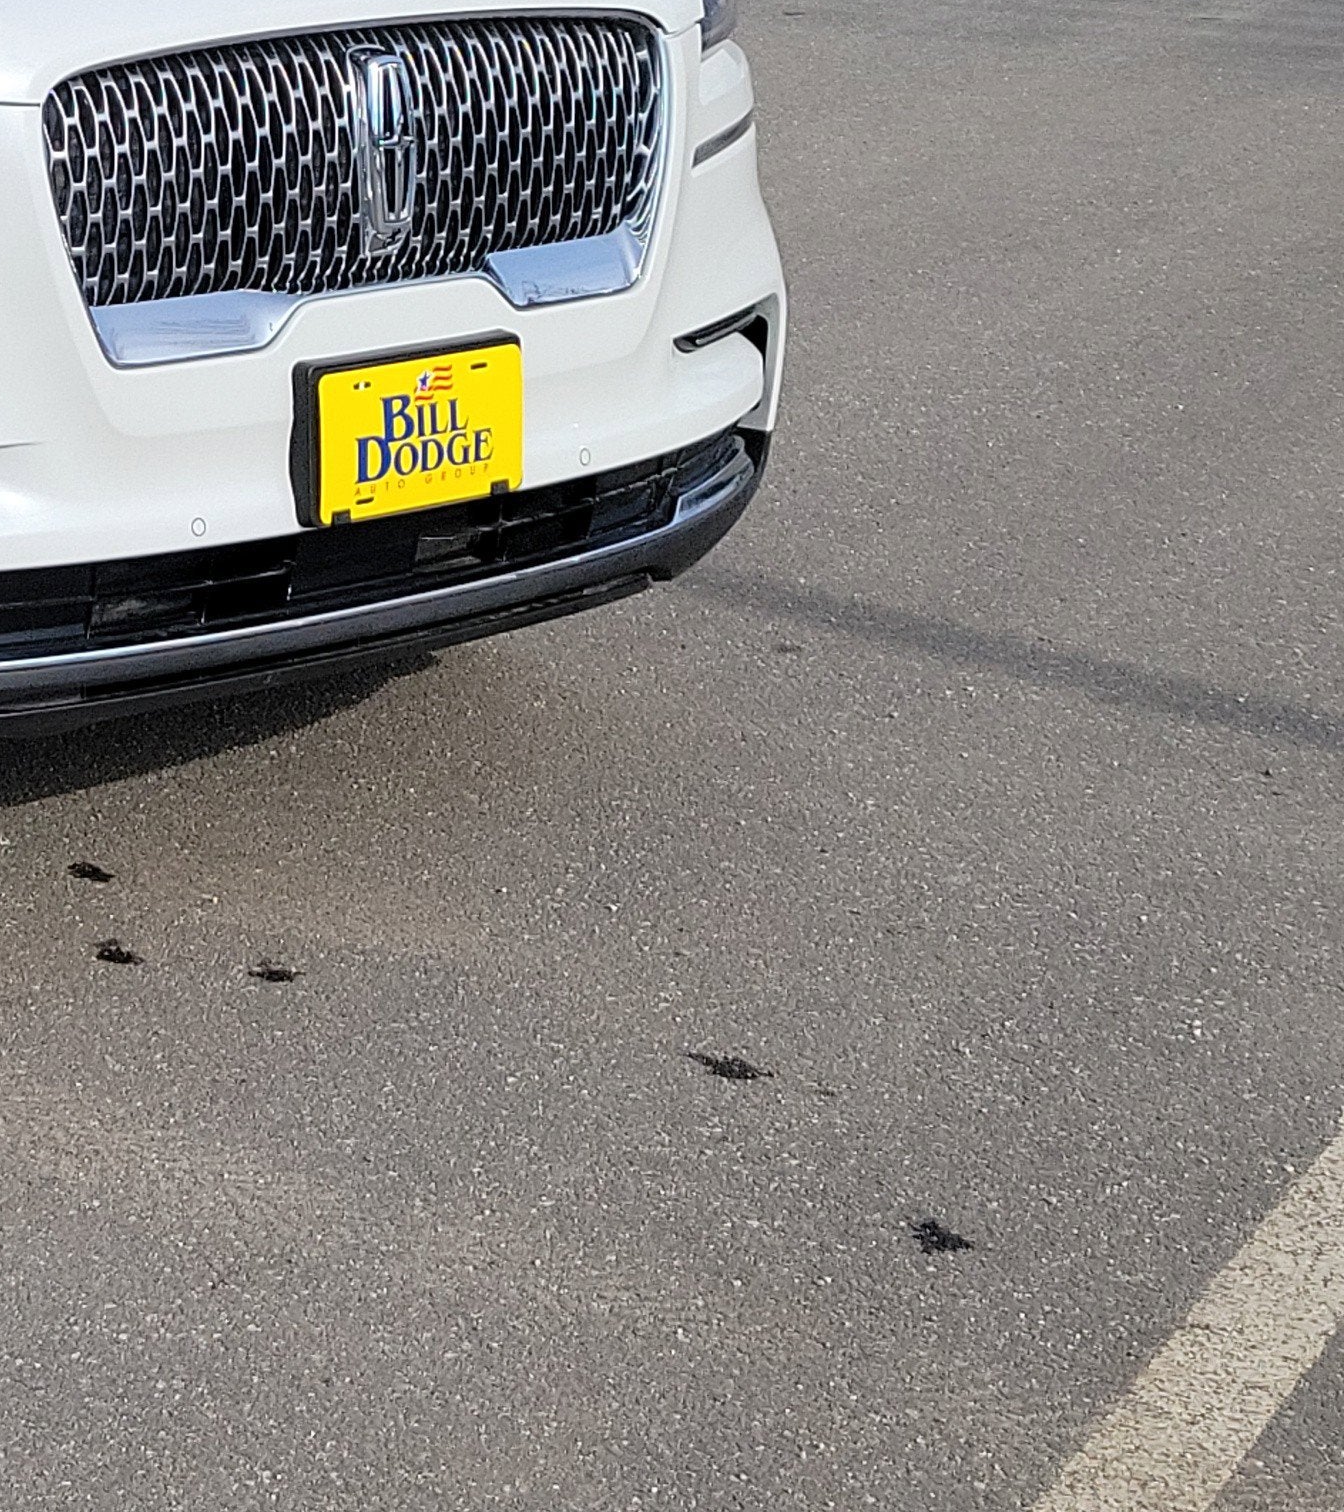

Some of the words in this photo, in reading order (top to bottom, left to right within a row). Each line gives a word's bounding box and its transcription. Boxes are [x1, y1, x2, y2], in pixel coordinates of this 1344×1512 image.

[380, 393, 470, 443] BILL
[354, 427, 495, 485] DODGE
[354, 478, 406, 497] AUTO
[424, 462, 489, 485] GROUP
